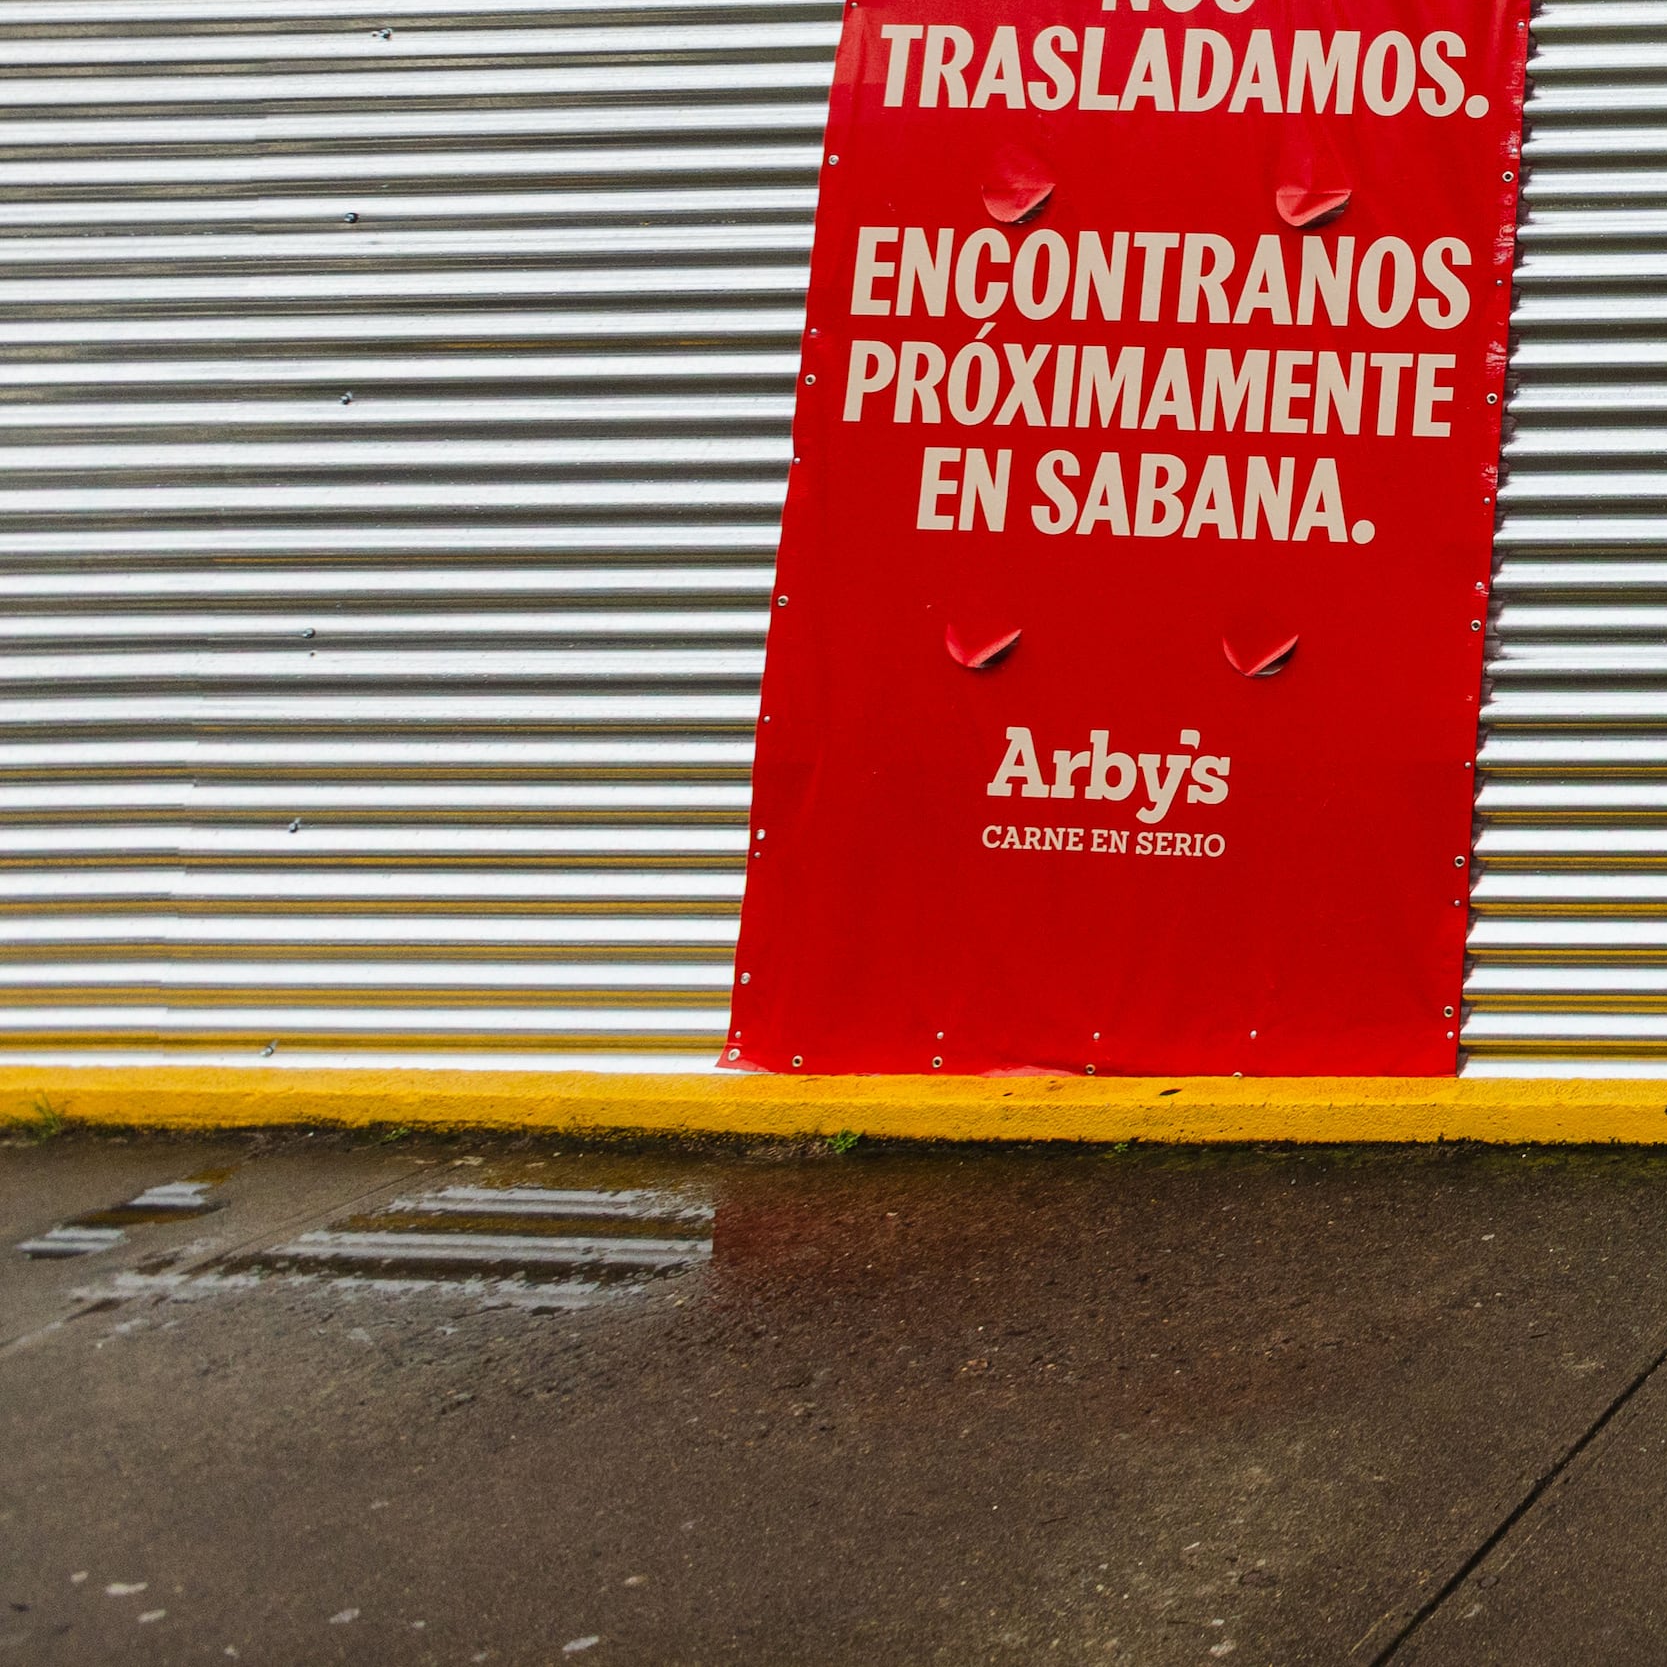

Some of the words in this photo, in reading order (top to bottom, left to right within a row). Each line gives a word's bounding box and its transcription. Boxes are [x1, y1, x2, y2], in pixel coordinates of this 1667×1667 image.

[880, 24, 1490, 119] TRASLADAMOS.
[850, 226, 1472, 331] ENCONTRANOS
[842, 320, 1457, 438] PRÓXIMAMENTE
[916, 446, 1009, 532] EN
[1031, 449, 1376, 545] SABANA.
[986, 726, 1231, 824] Arby's
[982, 825, 1084, 851] CARNE
[1090, 829, 1130, 854] EN
[1135, 831, 1226, 857] SERIO
